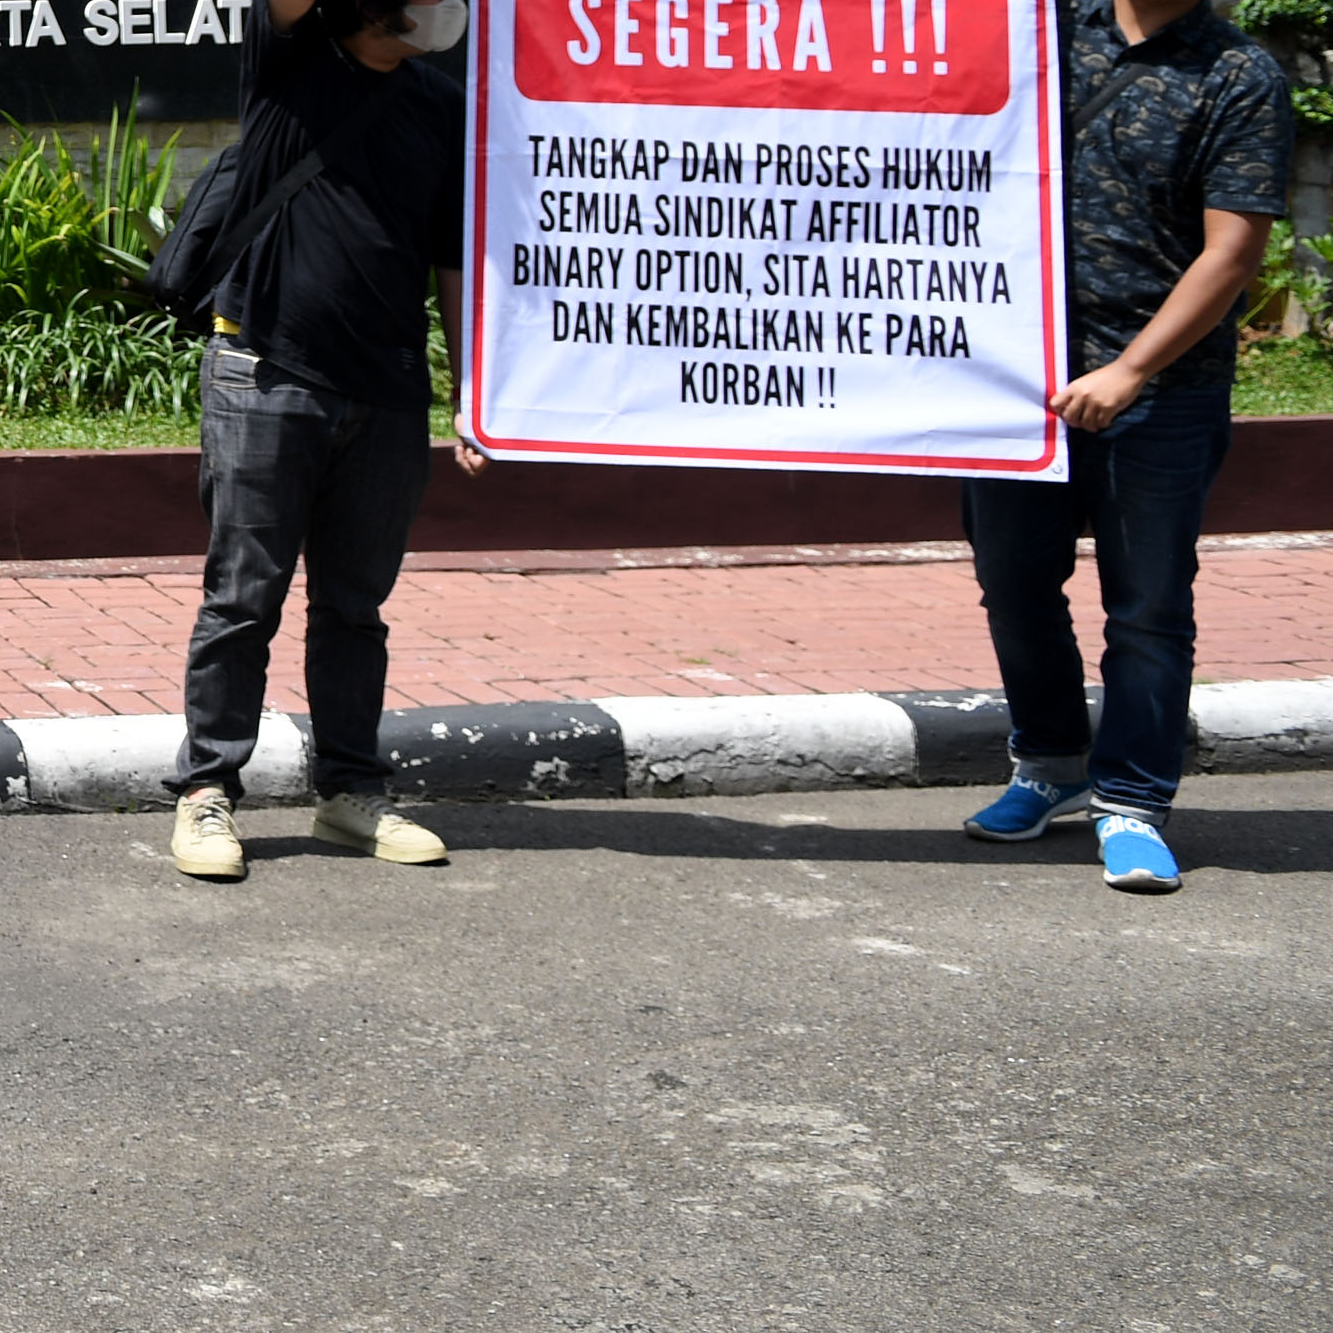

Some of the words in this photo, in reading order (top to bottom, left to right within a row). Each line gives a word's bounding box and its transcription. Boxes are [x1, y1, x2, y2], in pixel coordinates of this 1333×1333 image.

[528, 134, 670, 181] TANGKAP
[681, 141, 743, 184] DAN
[755, 143, 871, 189] PROSES
[882, 147, 992, 193] HUKUM
[538, 189, 643, 236] SEMUA
[653, 193, 798, 242] SINDIKAT
[806, 199, 981, 248] AFFILIATOR
[512, 242, 624, 290] BINARY
[635, 248, 752, 301] OPTION,
[763, 253, 831, 298] SITA
[842, 256, 1011, 304] HARTANYA
[552, 299, 614, 345] DAN
[626, 303, 823, 353] KEMBALIKAN
[837, 311, 873, 355] KE
[886, 313, 971, 359] PARA
[681, 361, 804, 408] KORBAN
[817, 367, 836, 409] !!
